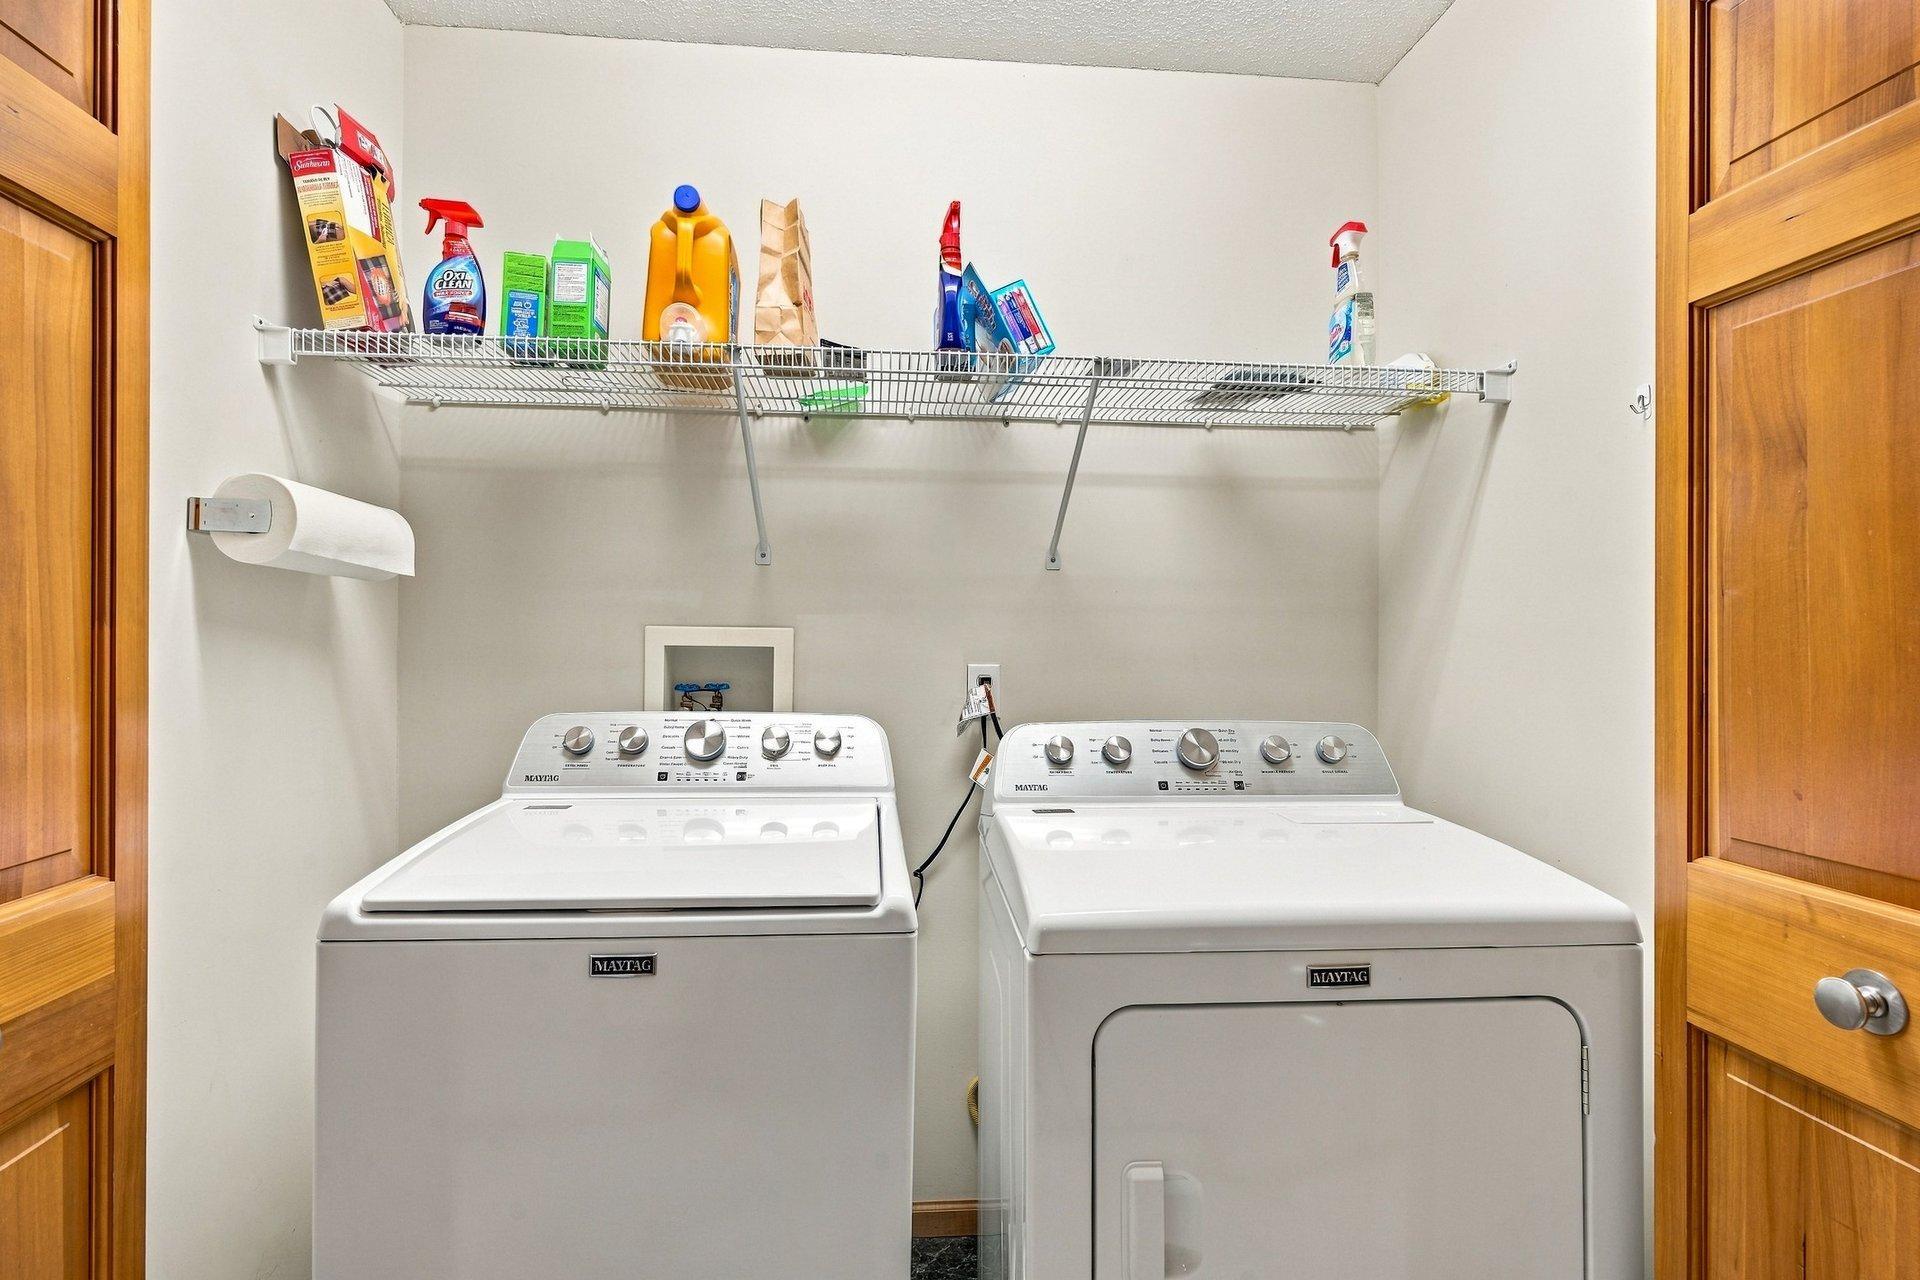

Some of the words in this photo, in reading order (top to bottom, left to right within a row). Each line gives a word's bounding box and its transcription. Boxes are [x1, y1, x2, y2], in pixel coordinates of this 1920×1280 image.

[294, 160, 330, 172] Sunbeam
[435, 279, 472, 289] CLEAN
[594, 960, 651, 971] MAYTAG
[1313, 971, 1367, 983] MAYTAG
